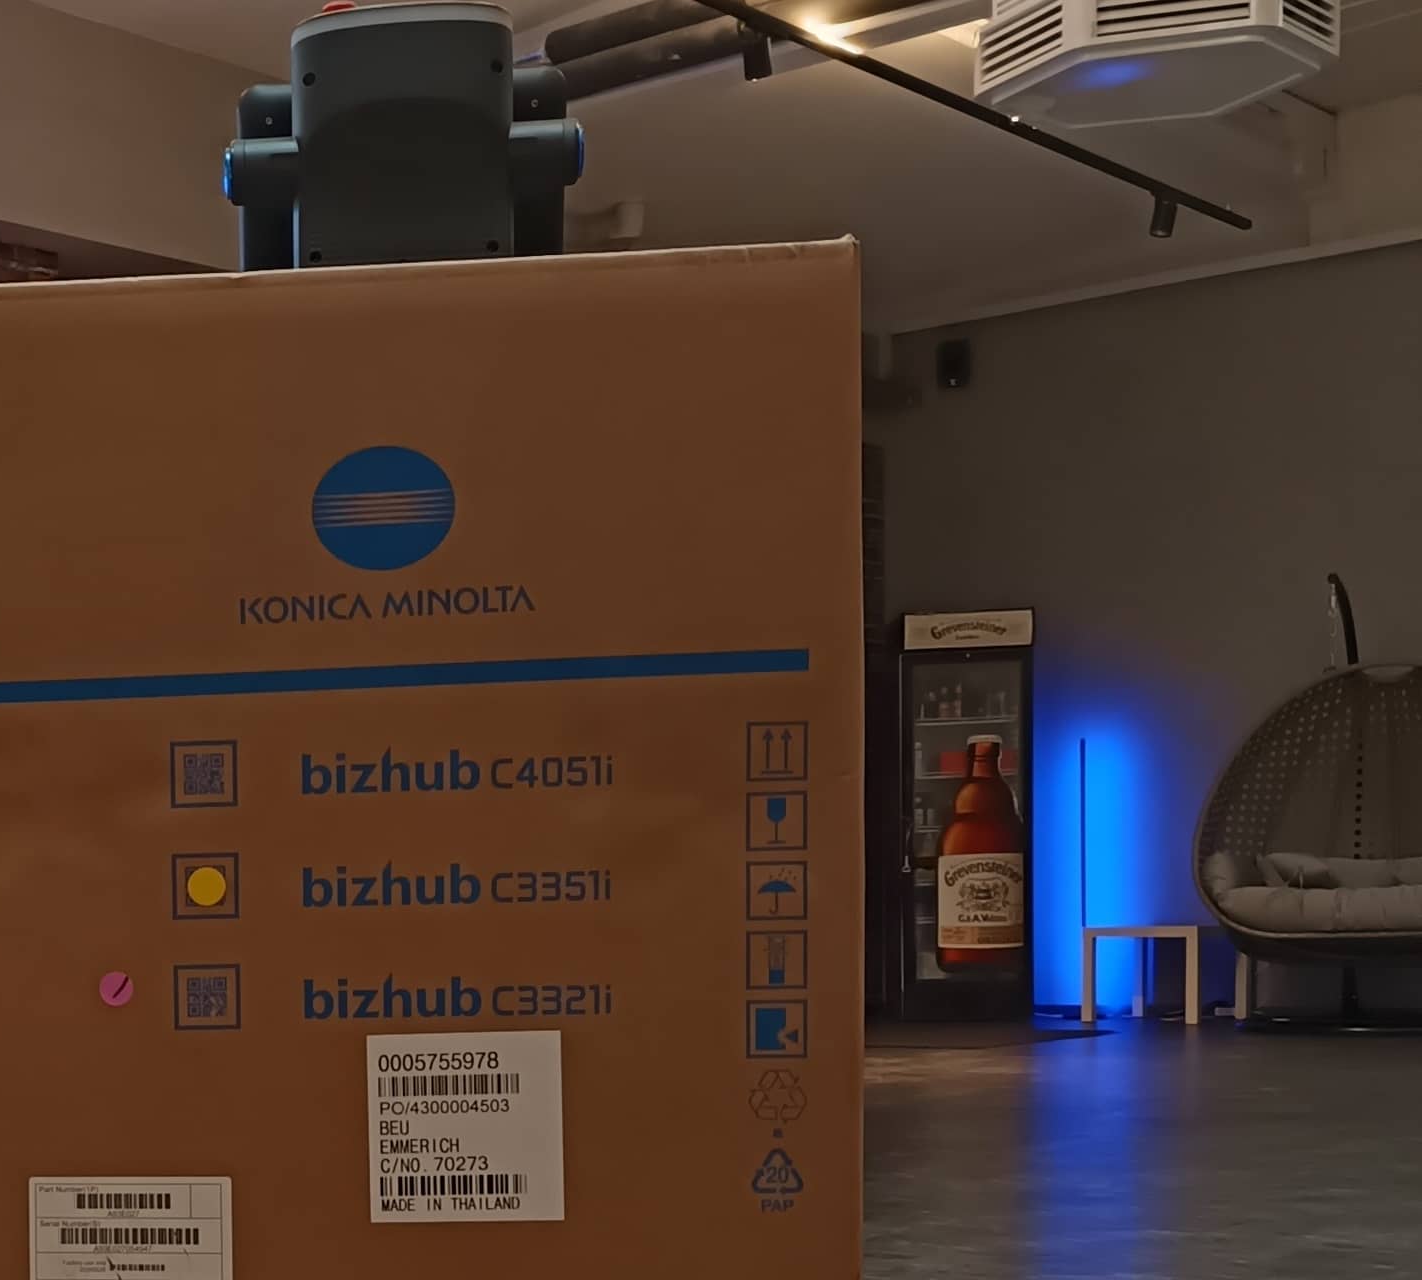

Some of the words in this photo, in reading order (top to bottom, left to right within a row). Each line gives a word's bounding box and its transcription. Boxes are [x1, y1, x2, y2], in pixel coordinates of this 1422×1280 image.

[239, 593, 372, 625] KONICA
[381, 585, 536, 618] MINOLTA
[301, 746, 481, 795] bizhub
[491, 755, 613, 789] C4051i
[302, 860, 482, 908] bizhub
[491, 870, 611, 903] C3351i
[303, 972, 482, 1020] bizhub
[492, 984, 611, 1016] C3321i
[378, 1051, 499, 1072] 0005755978
[380, 1099, 510, 1115] PO/4300004503
[379, 1120, 410, 1136] BEU
[380, 1138, 460, 1154] EMMERICH
[380, 1157, 427, 1174] C/NO.
[434, 1156, 489, 1171] 70273
[765, 1166, 789, 1183] 20
[381, 1198, 416, 1212] MADE
[427, 1197, 442, 1211] IN
[451, 1196, 520, 1211] THAILAND
[761, 1199, 795, 1213] PAP
